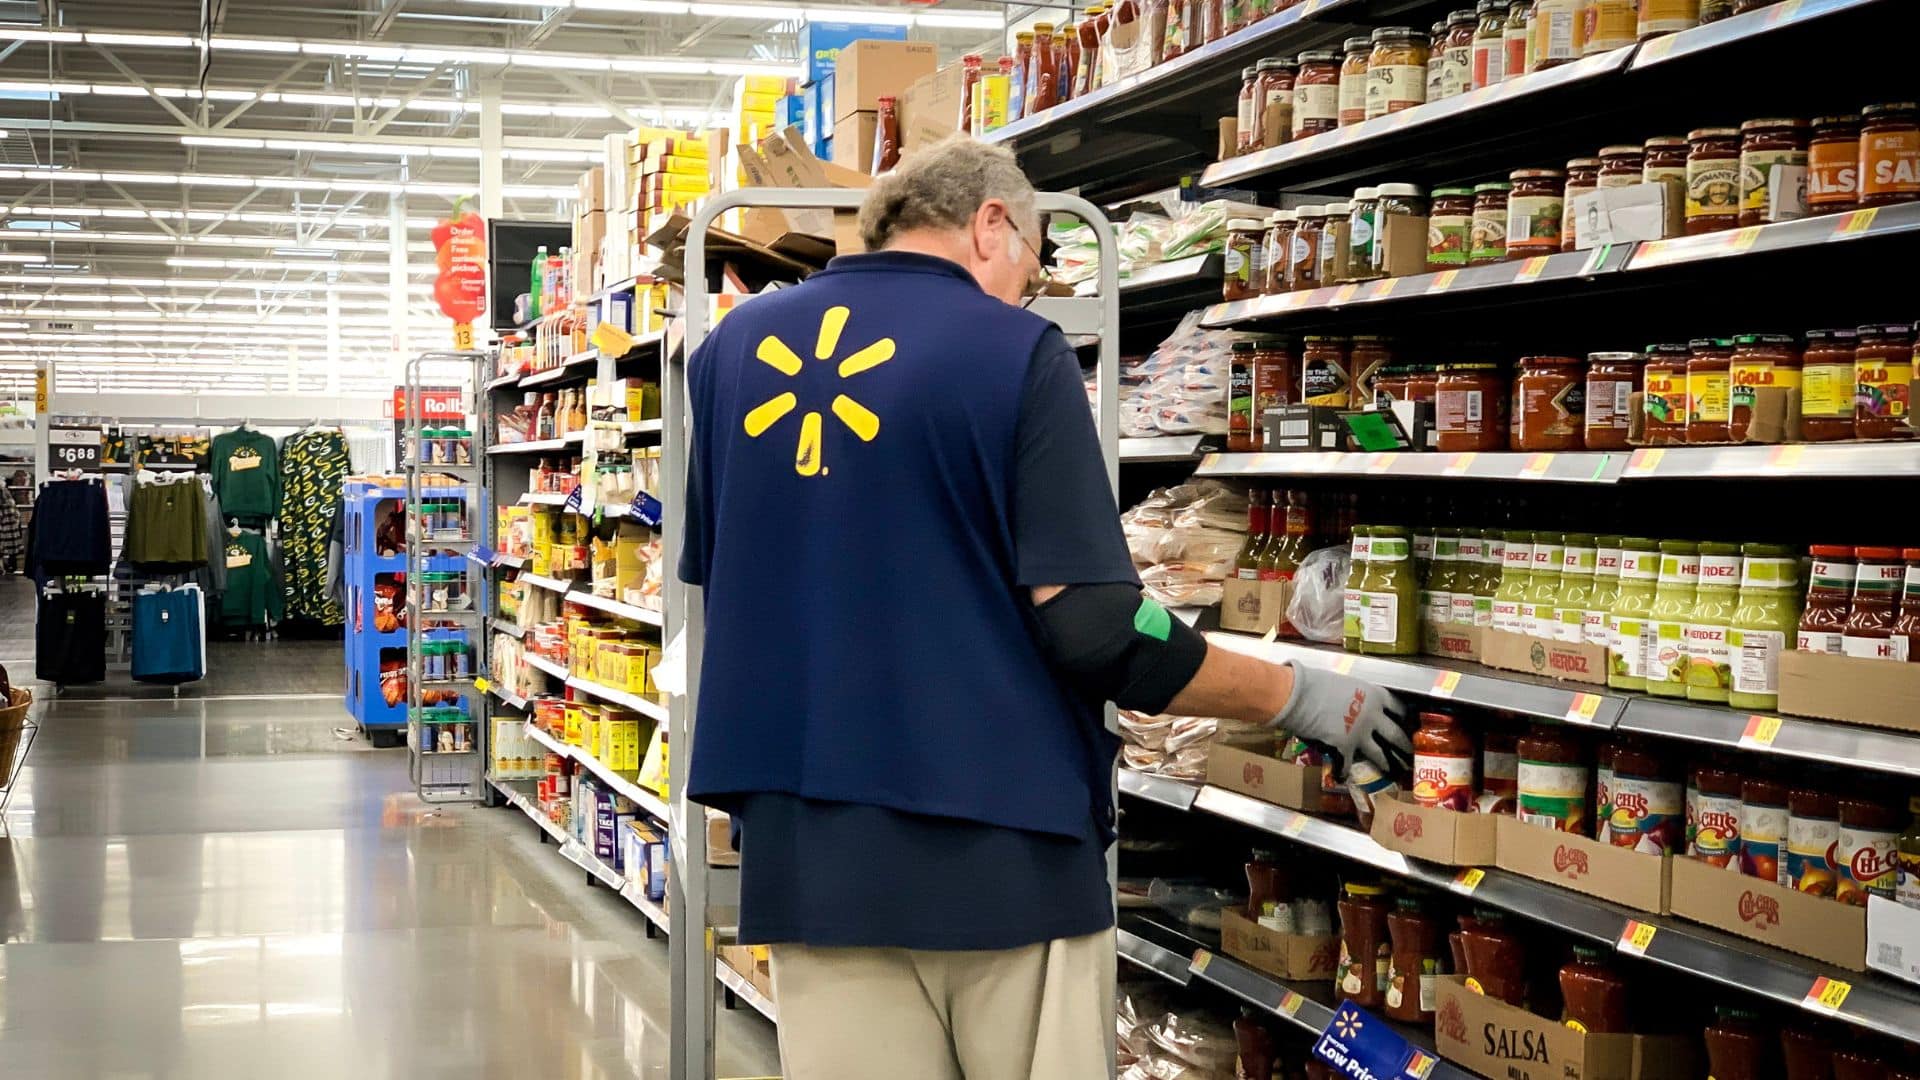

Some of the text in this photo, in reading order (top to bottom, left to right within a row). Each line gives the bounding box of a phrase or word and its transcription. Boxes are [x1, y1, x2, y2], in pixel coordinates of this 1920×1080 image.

[1808, 168, 1857, 193] ALS
[457, 331, 471, 345] 13
[1305, 375, 1337, 386] ORDER
[1737, 369, 1775, 385] GOLD
[1440, 636, 1473, 654] HERDEZ
[1550, 651, 1590, 673] HERDEZ
[1318, 1039, 1348, 1067] Low
[1483, 1022, 1550, 1065] SALSA
